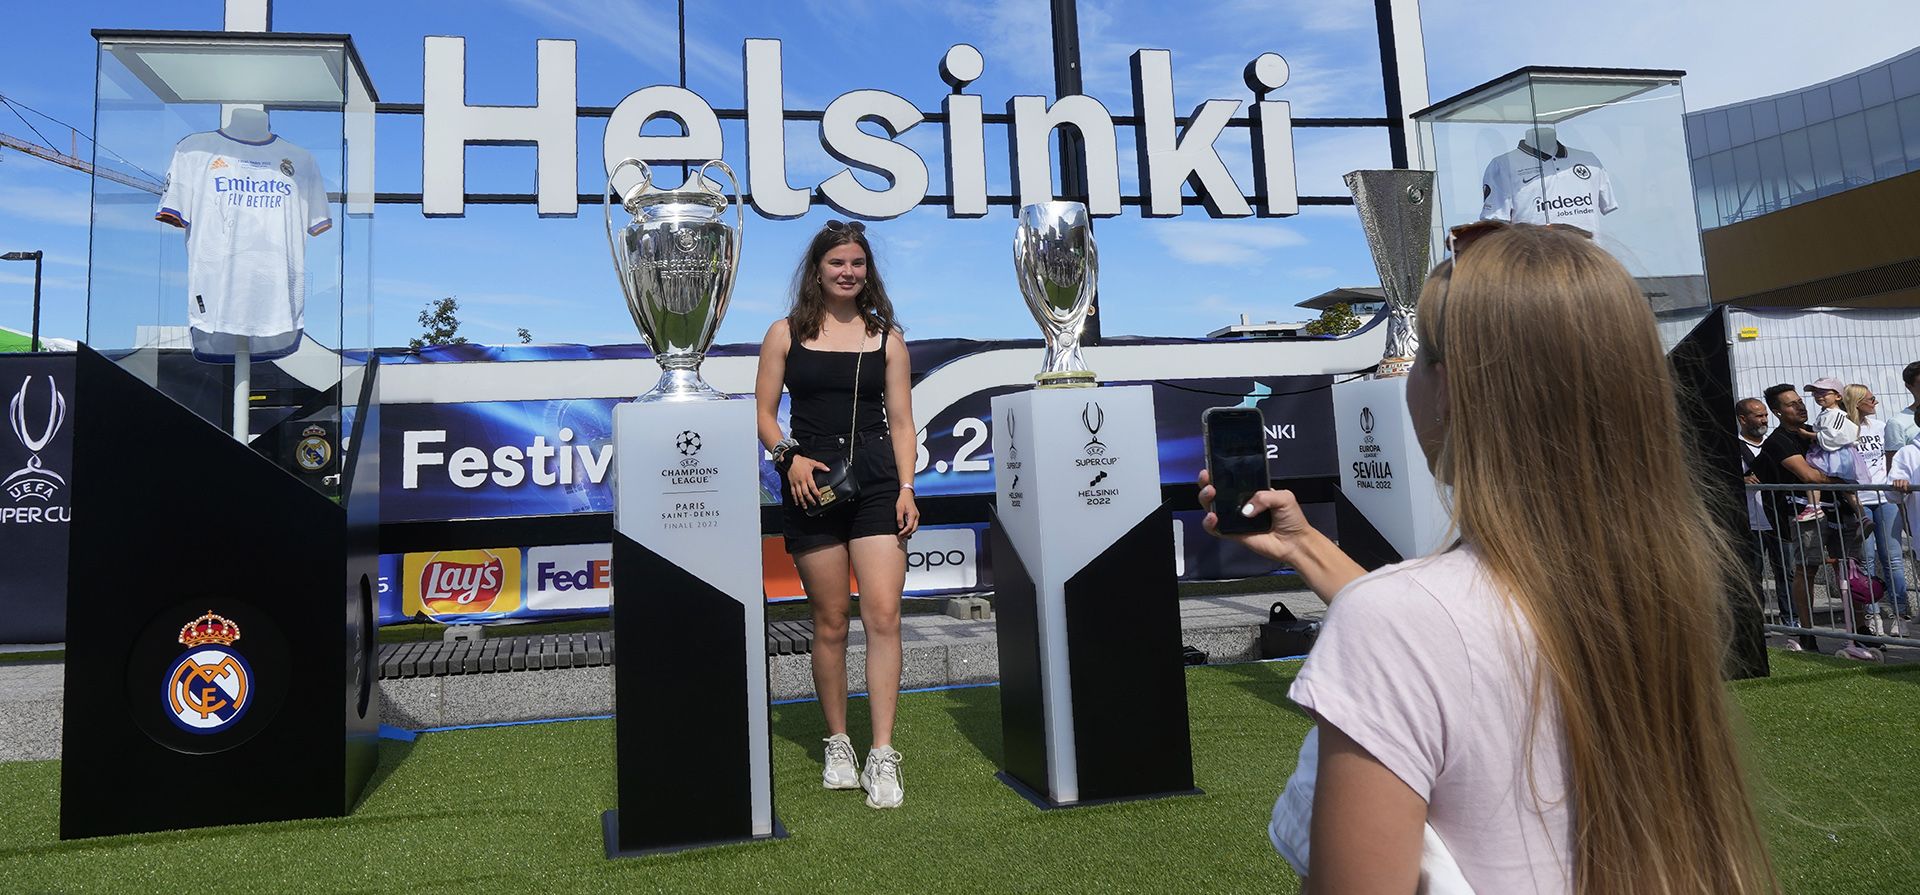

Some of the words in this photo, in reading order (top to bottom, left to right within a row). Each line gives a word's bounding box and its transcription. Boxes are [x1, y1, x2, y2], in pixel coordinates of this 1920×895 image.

[421, 36, 1300, 220] Helsinki
[214, 176, 292, 196] Emirates
[228, 193, 243, 206] FLY
[246, 194, 282, 208] BETTER
[1535, 192, 1593, 212] indeed
[1263, 424, 1296, 440] NKI
[1266, 444, 1279, 459] 2
[1359, 445, 1381, 453] EUROPA
[402, 427, 613, 489] Festiv
[1075, 458, 1101, 467] SUPER
[1101, 457, 1118, 466] CUP
[661, 467, 719, 477] CHAMPIONS
[671, 476, 709, 485] LEAGUE
[1357, 480, 1375, 489] FINAL
[1375, 481, 1392, 489] 2022
[9, 482, 54, 498] UEFA
[1078, 489, 1120, 497] HELSINKI
[675, 502, 705, 511] PARIS
[1086, 497, 1111, 505] 2022
[0, 506, 43, 524] PER
[44, 506, 72, 522] CU
[661, 510, 720, 519] SAINT-DENIS
[906, 550, 965, 573] ppo
[425, 560, 500, 605] Lay's
[537, 559, 612, 592] FedE
